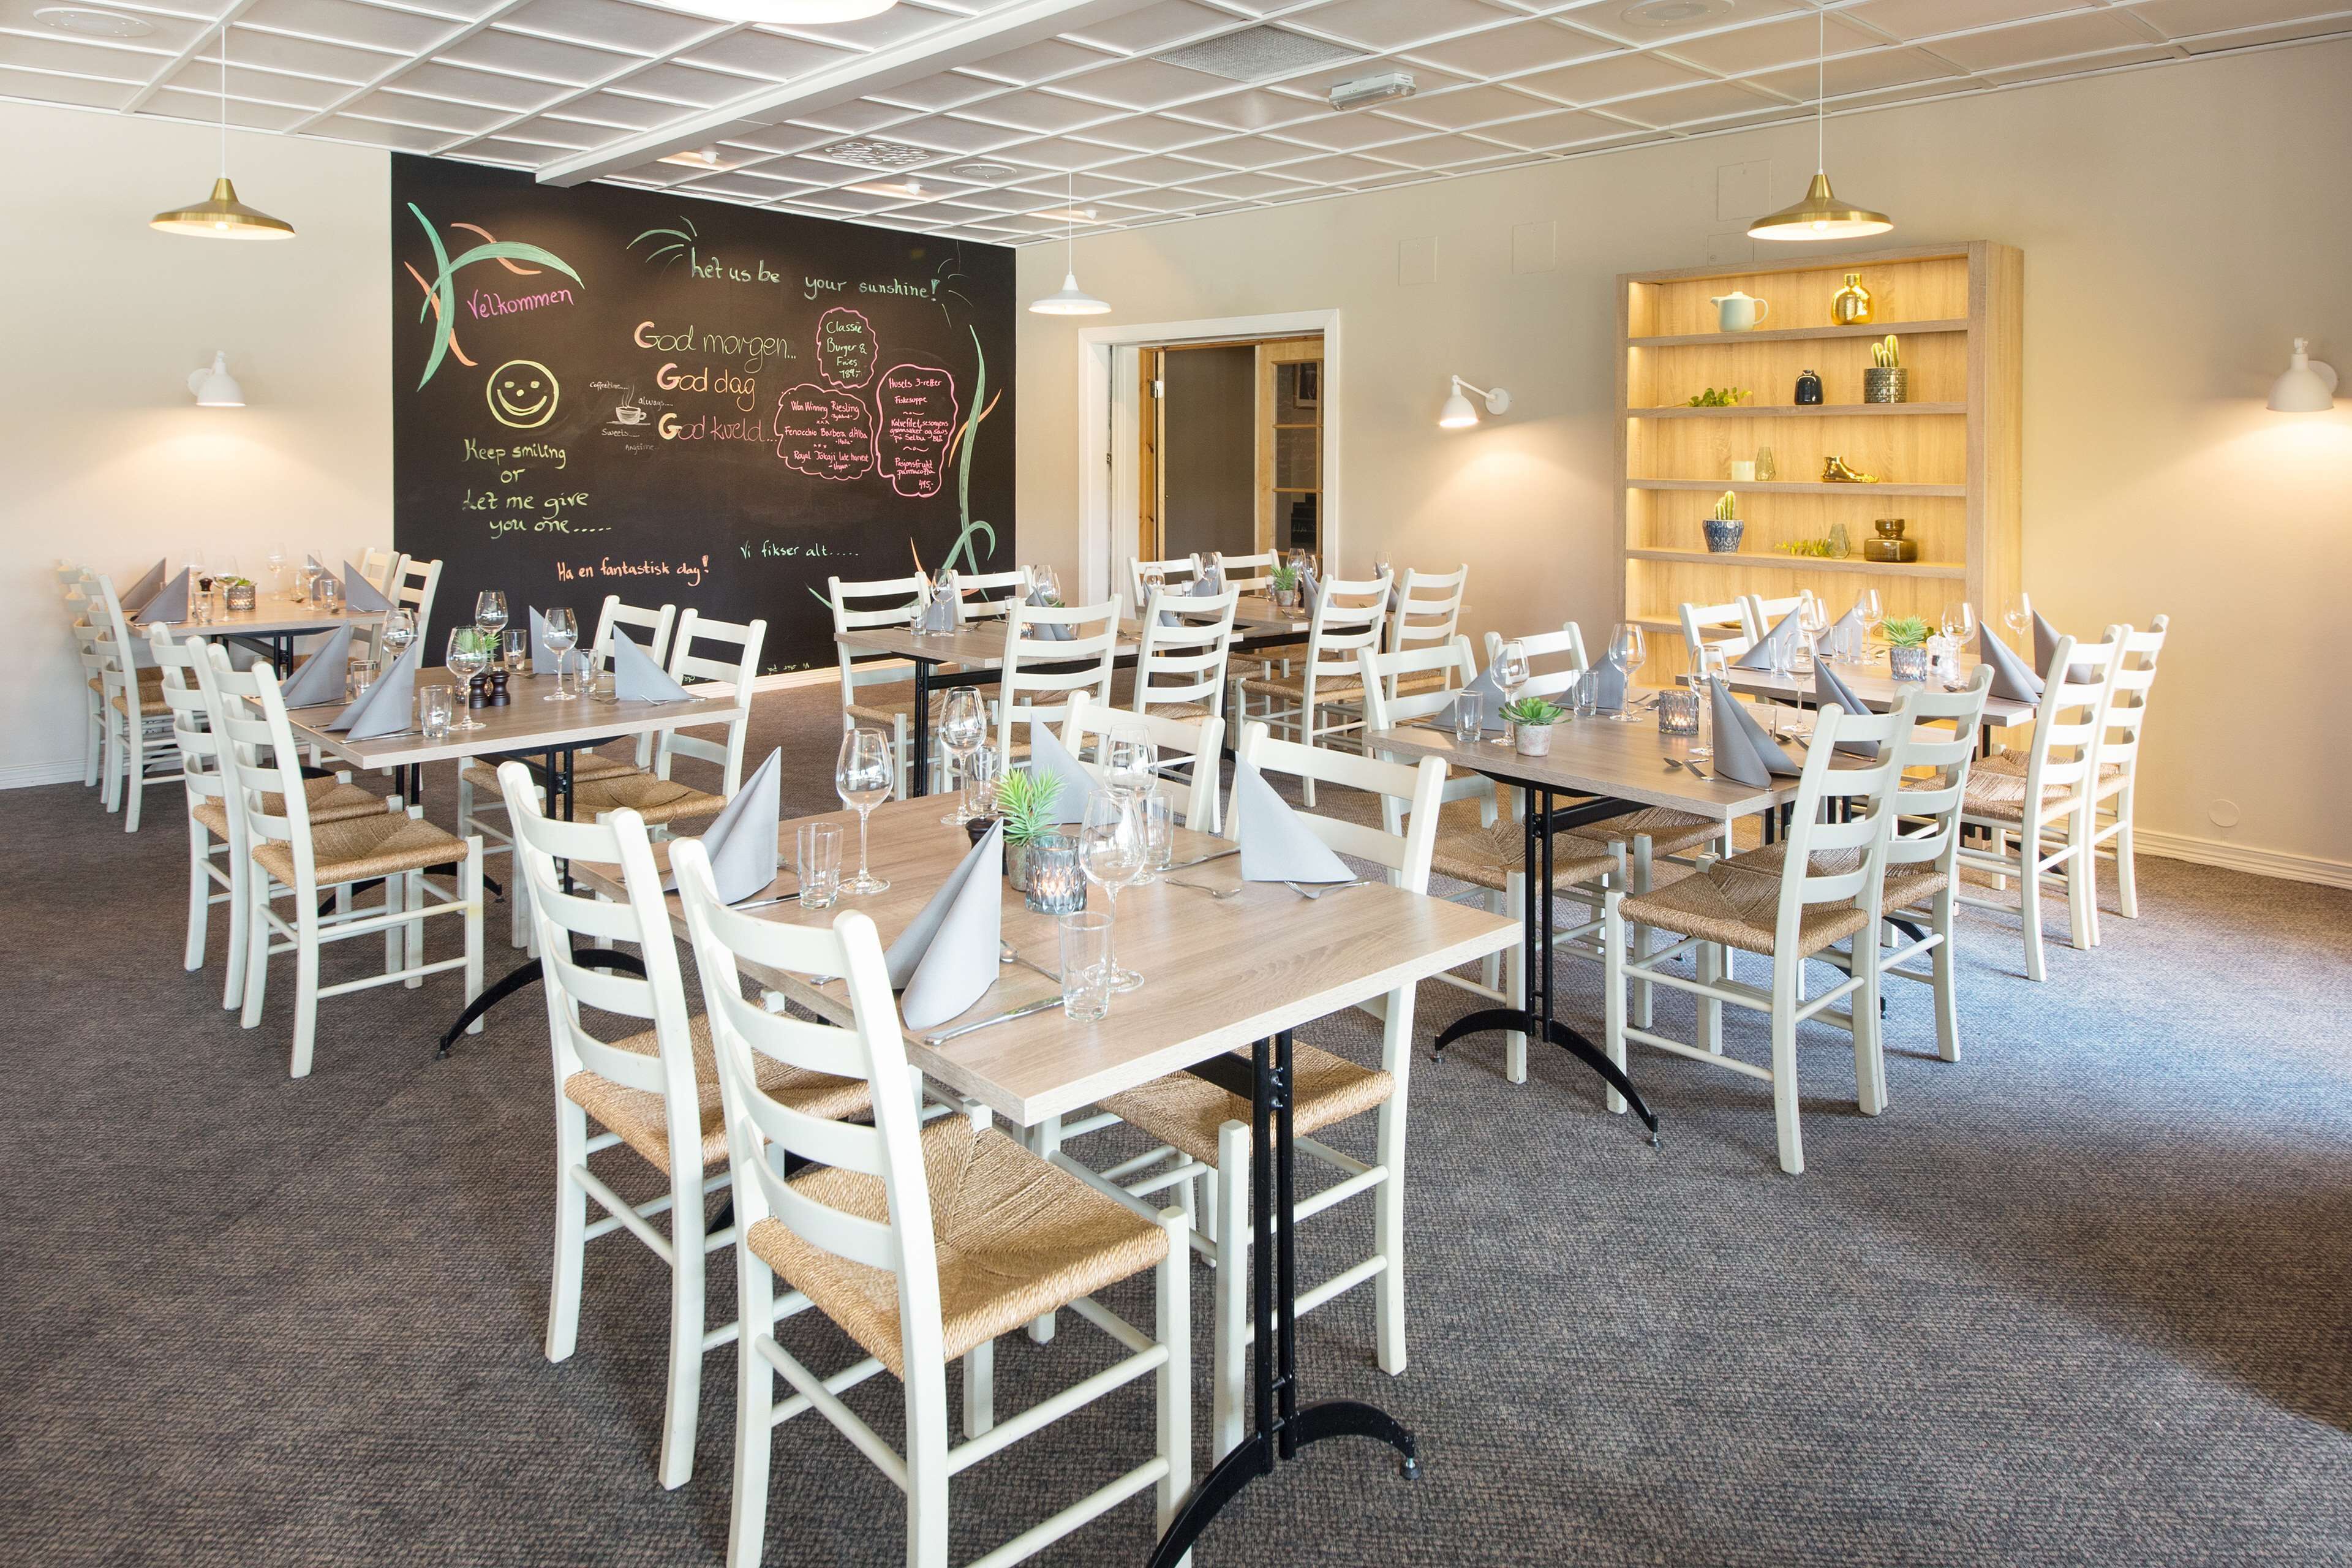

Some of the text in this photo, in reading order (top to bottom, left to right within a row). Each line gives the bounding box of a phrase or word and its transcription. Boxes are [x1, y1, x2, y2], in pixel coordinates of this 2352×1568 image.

[729, 268, 752, 281] us
[758, 260, 781, 283] be
[804, 276, 847, 301] your
[859, 278, 941, 301] sunshine!
[467, 288, 575, 319] Velkommen
[634, 321, 696, 352] God
[827, 337, 857, 357] Burger
[837, 356, 858, 367] Fries
[657, 363, 755, 412] God dag
[804, 400, 828, 420] Winning
[830, 401, 860, 421] Riesling
[894, 395, 928, 405] Fiskesuppe
[658, 413, 705, 440] God
[784, 426, 817, 436] Fenocchio
[924, 429, 933, 439] og
[904, 433, 927, 442] Selbu
[461, 437, 567, 470] Keep smiling
[793, 450, 812, 464] Royal
[500, 468, 526, 484] or
[506, 496, 535, 510] me
[542, 492, 589, 520] give
[489, 519, 527, 540] you
[740, 540, 751, 559] Vi
[761, 540, 799, 558] fikser
[557, 561, 575, 582] Ha
[578, 565, 594, 578] en
[600, 556, 670, 577] fantastisk
